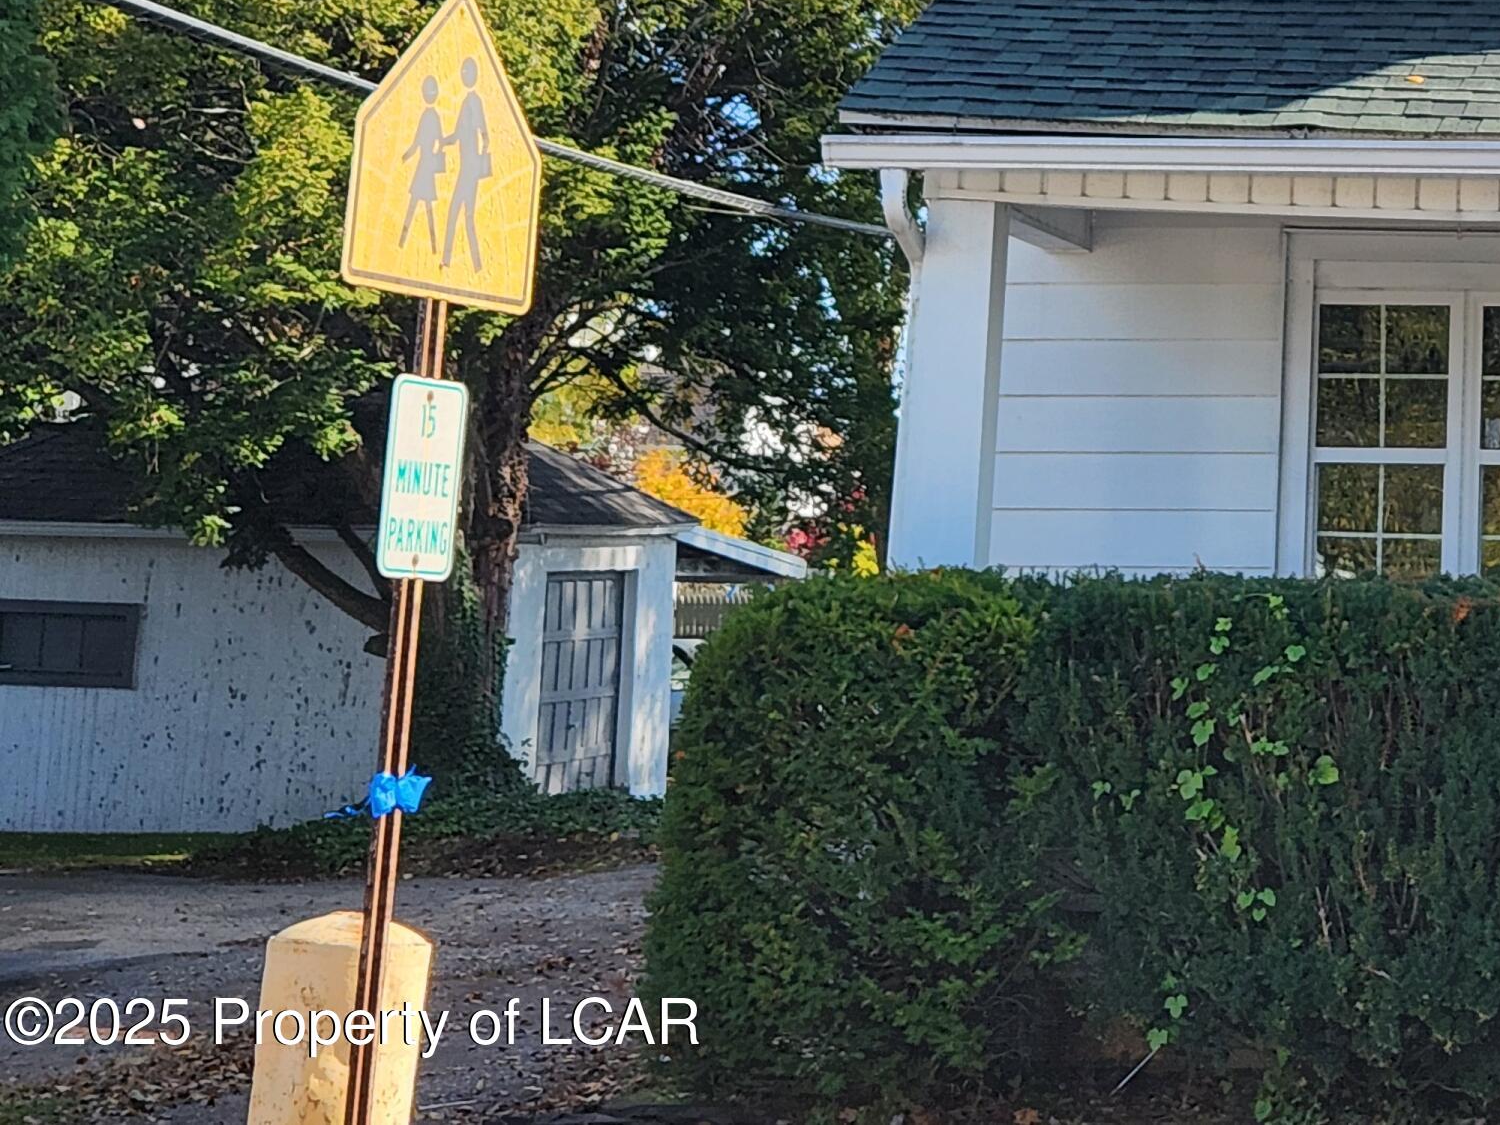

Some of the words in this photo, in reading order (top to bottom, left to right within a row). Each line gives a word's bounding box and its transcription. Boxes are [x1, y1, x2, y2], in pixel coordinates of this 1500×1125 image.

[420, 404, 436, 439] 15
[395, 460, 450, 498] MINUTE
[387, 517, 448, 556] PARKING
